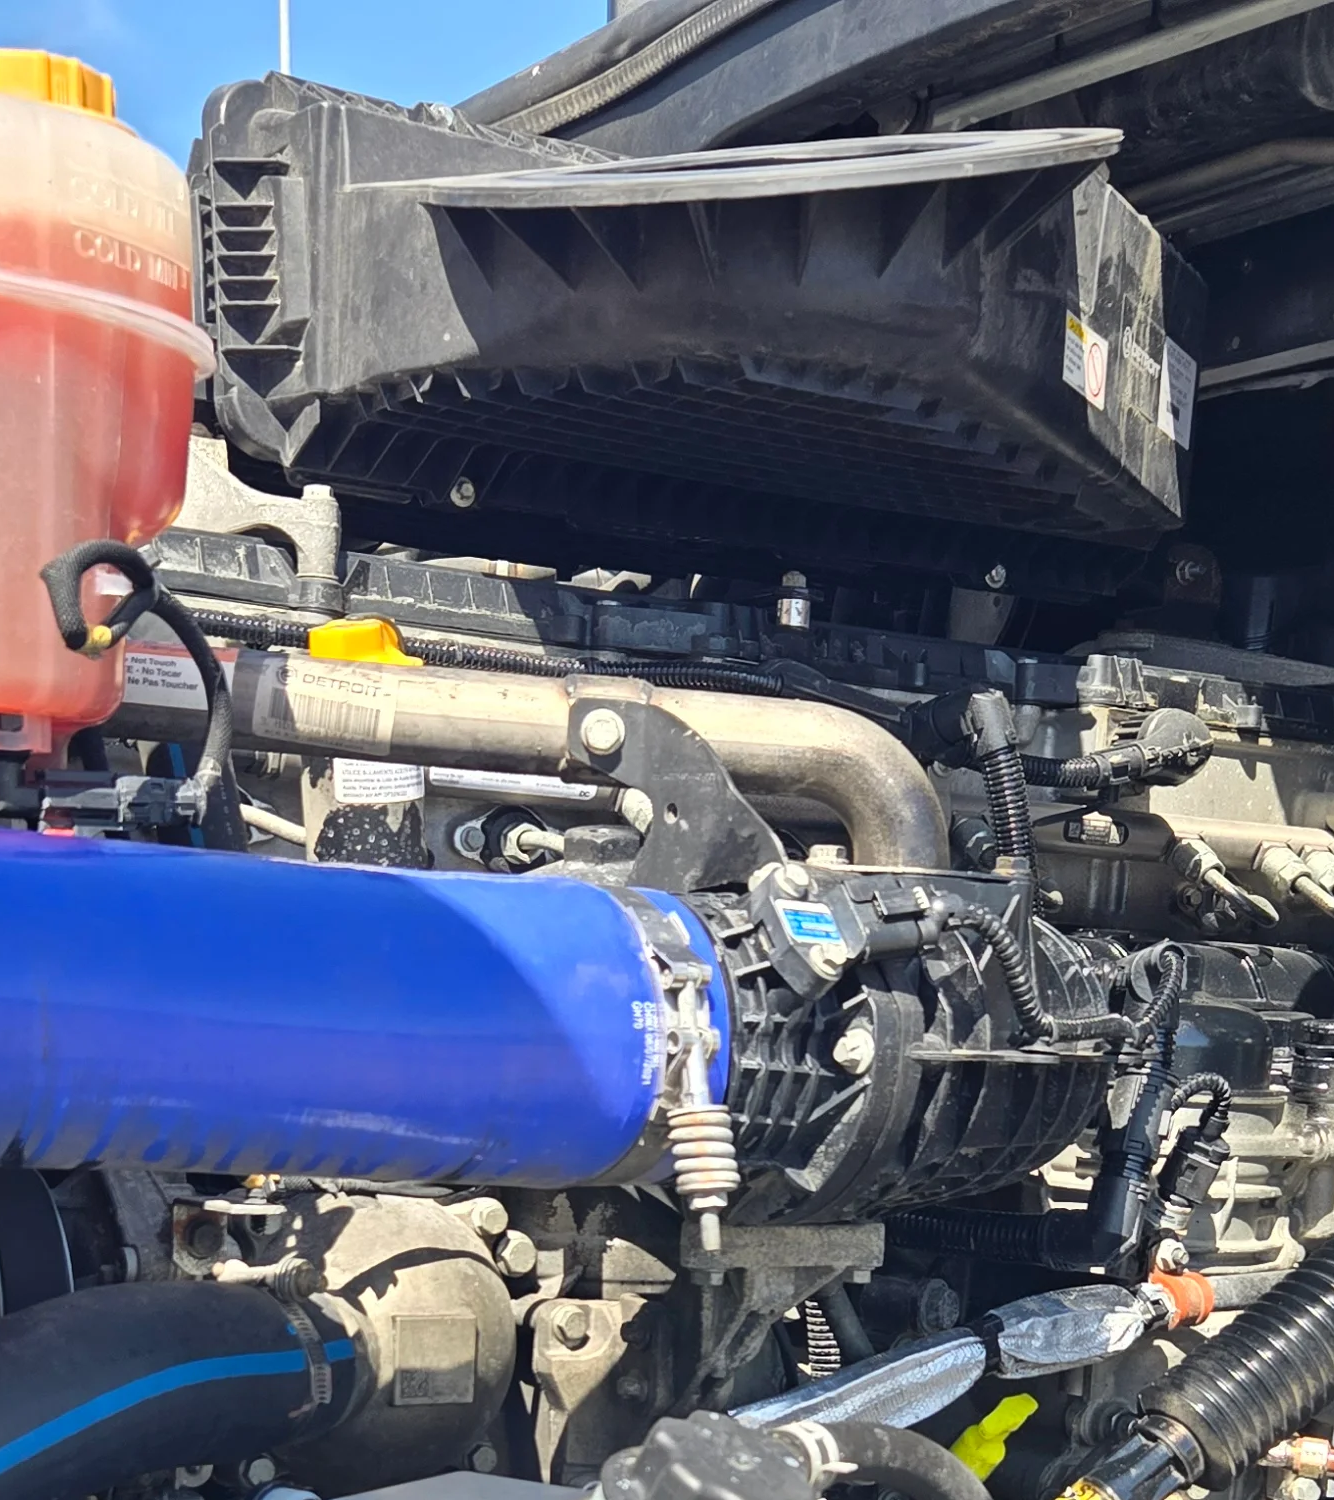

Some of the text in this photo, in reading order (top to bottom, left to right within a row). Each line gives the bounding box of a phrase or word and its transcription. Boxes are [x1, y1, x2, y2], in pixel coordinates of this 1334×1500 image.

[74, 229, 141, 271] COLD
[149, 657, 177, 667] Touch
[157, 668, 183, 678] Tocar
[142, 677, 159, 687] Pas
[161, 679, 198, 690] Toucher
[302, 673, 381, 697] DETROIT
